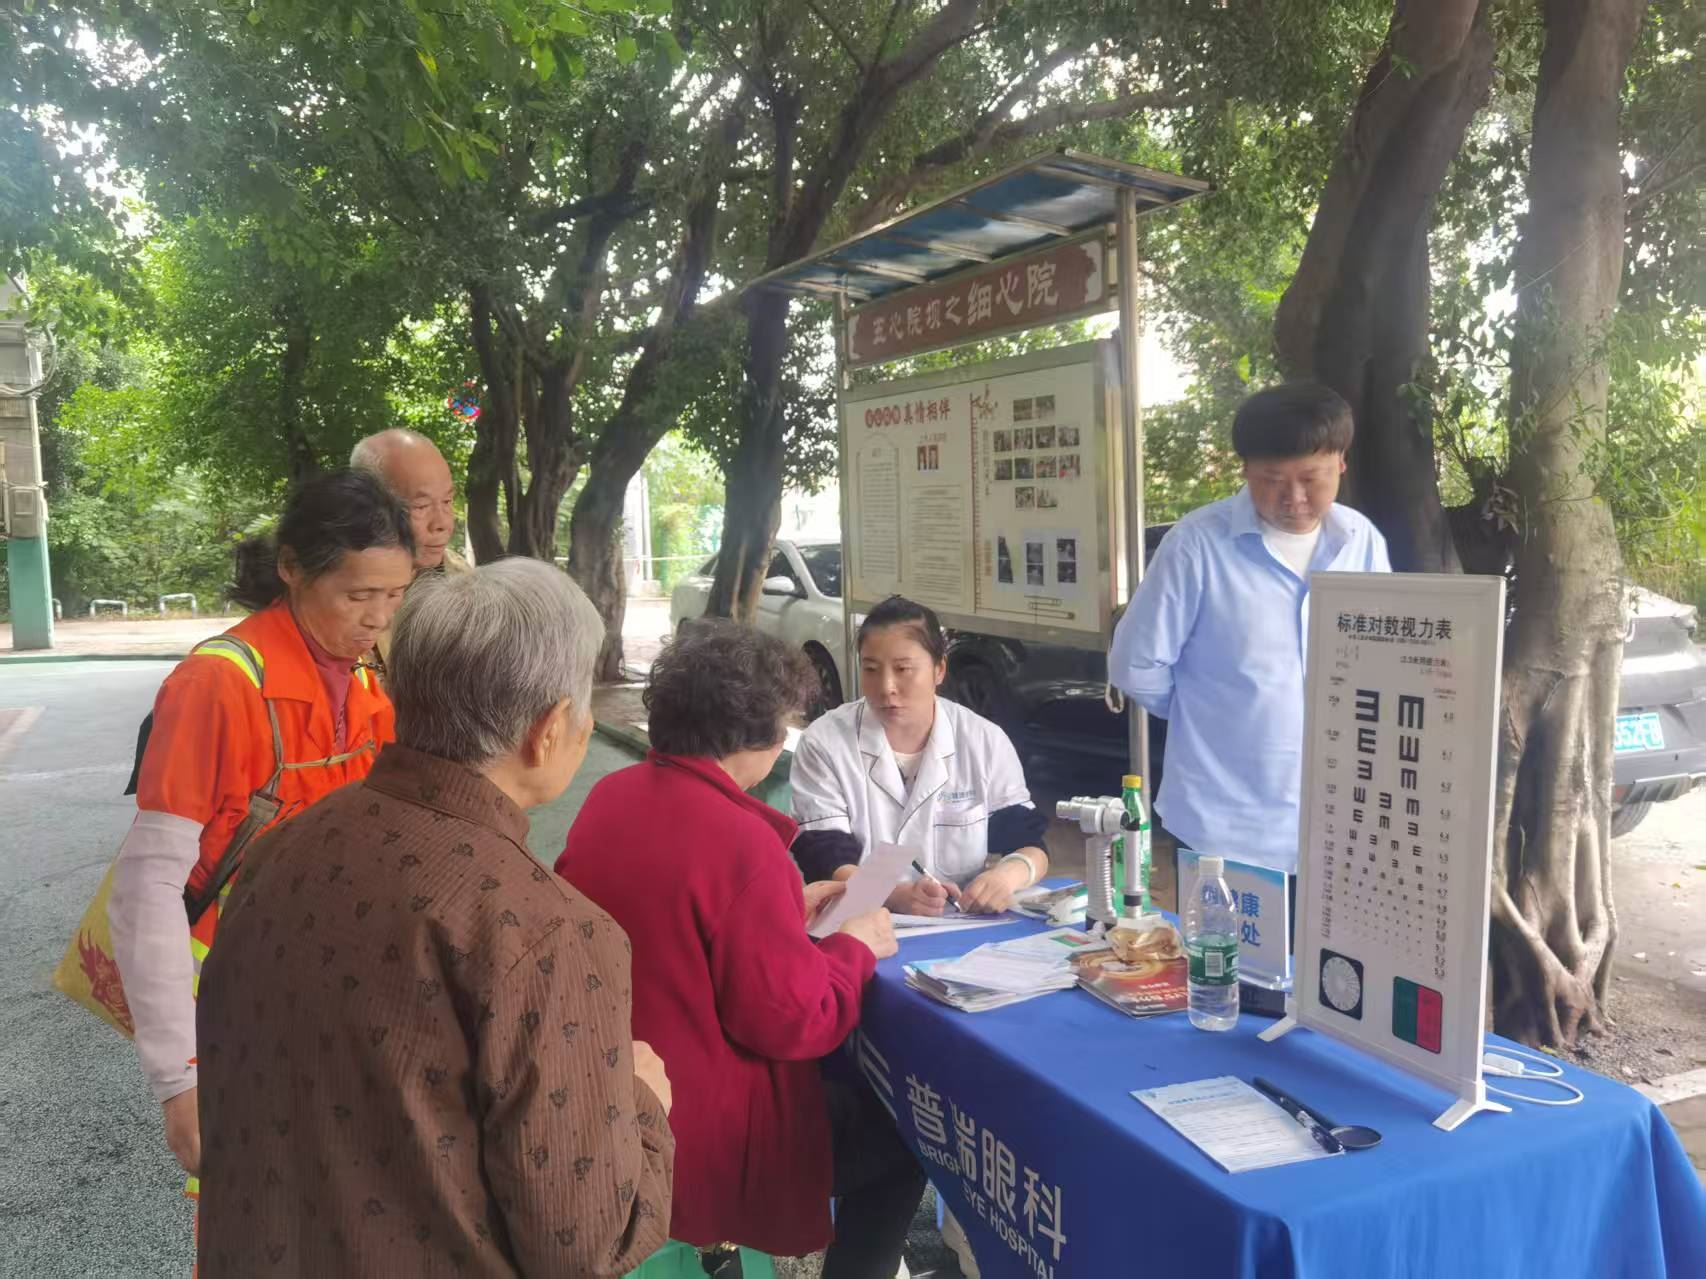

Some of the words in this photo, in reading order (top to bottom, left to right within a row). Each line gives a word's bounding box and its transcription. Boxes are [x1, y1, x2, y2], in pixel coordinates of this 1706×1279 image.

[1337, 612, 1453, 641] 标准对数视力表
[916, 1137, 966, 1177] BRIGH
